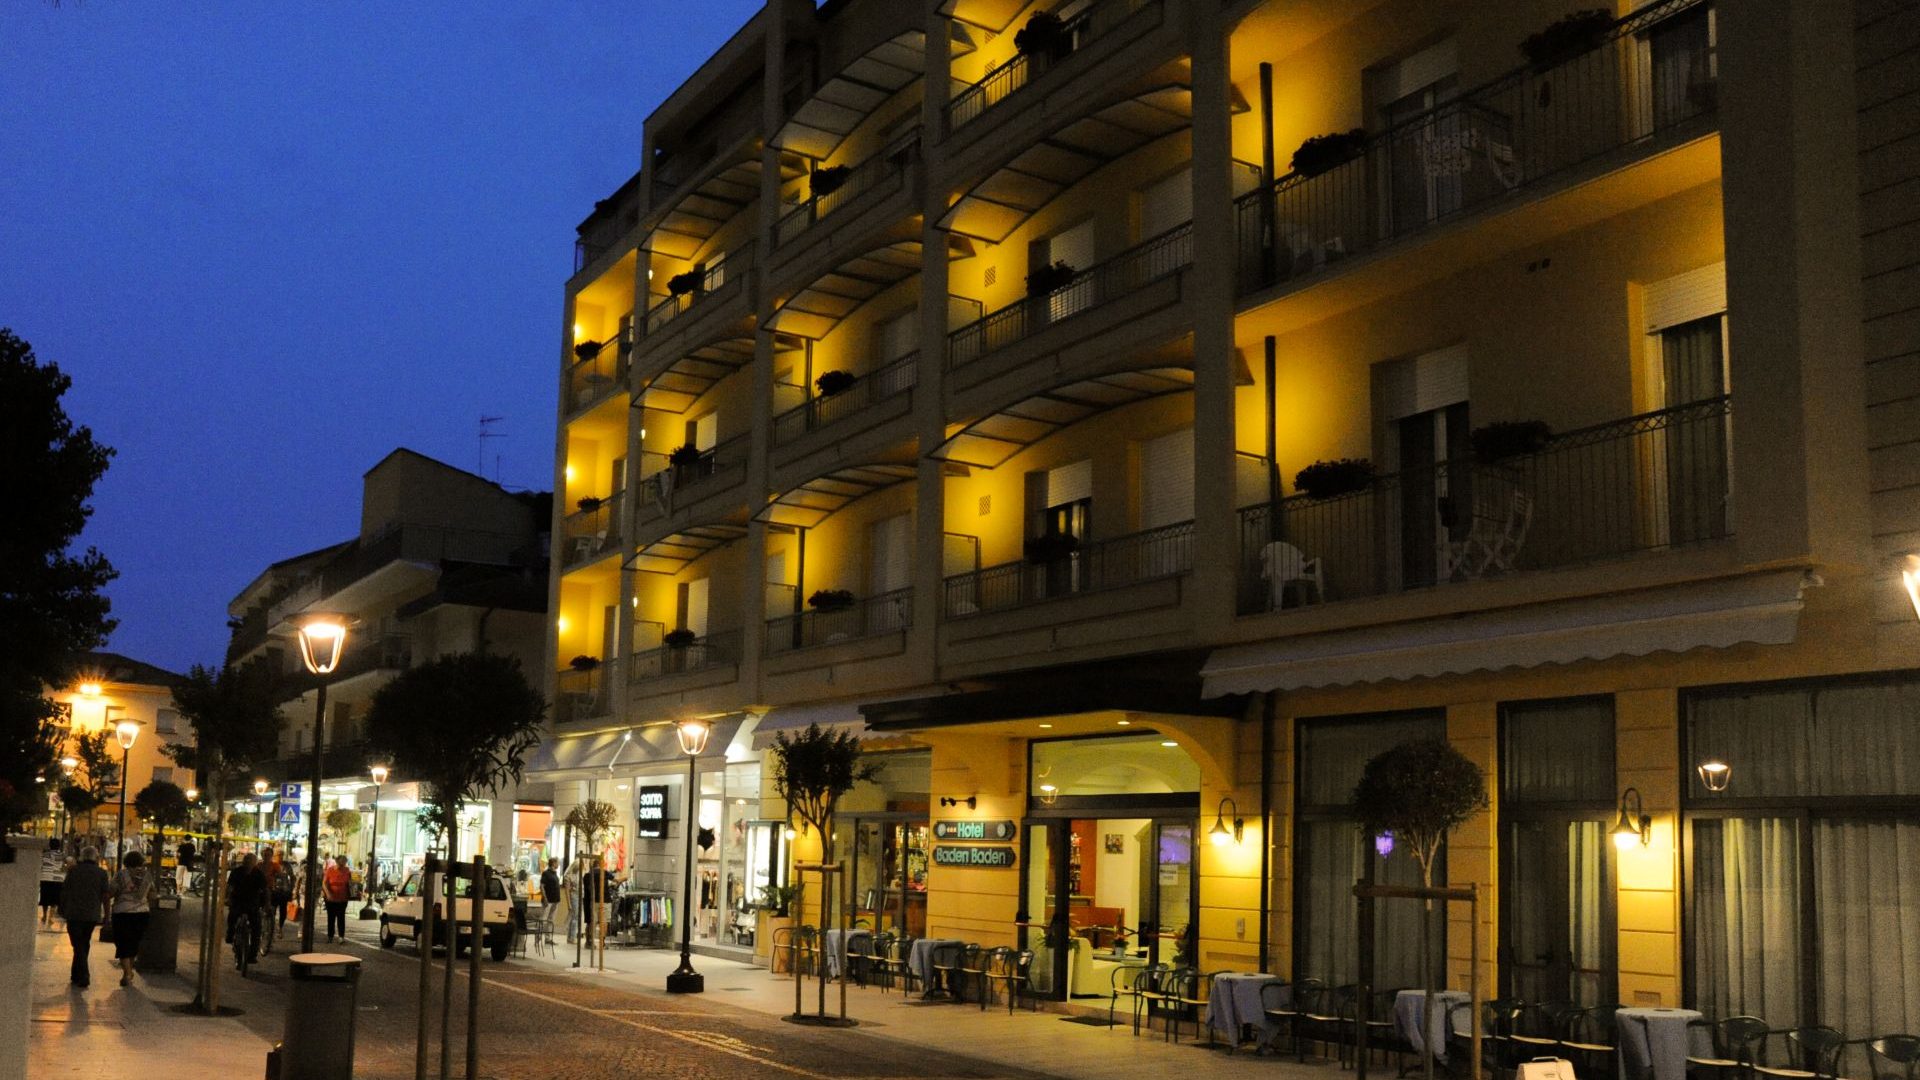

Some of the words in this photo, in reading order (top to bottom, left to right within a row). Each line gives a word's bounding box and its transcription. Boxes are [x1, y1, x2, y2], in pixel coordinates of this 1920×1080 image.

[286, 784, 297, 797] P
[957, 822, 984, 838] Hotel
[936, 847, 969, 863] Baden
[971, 848, 1006, 865] Baden
